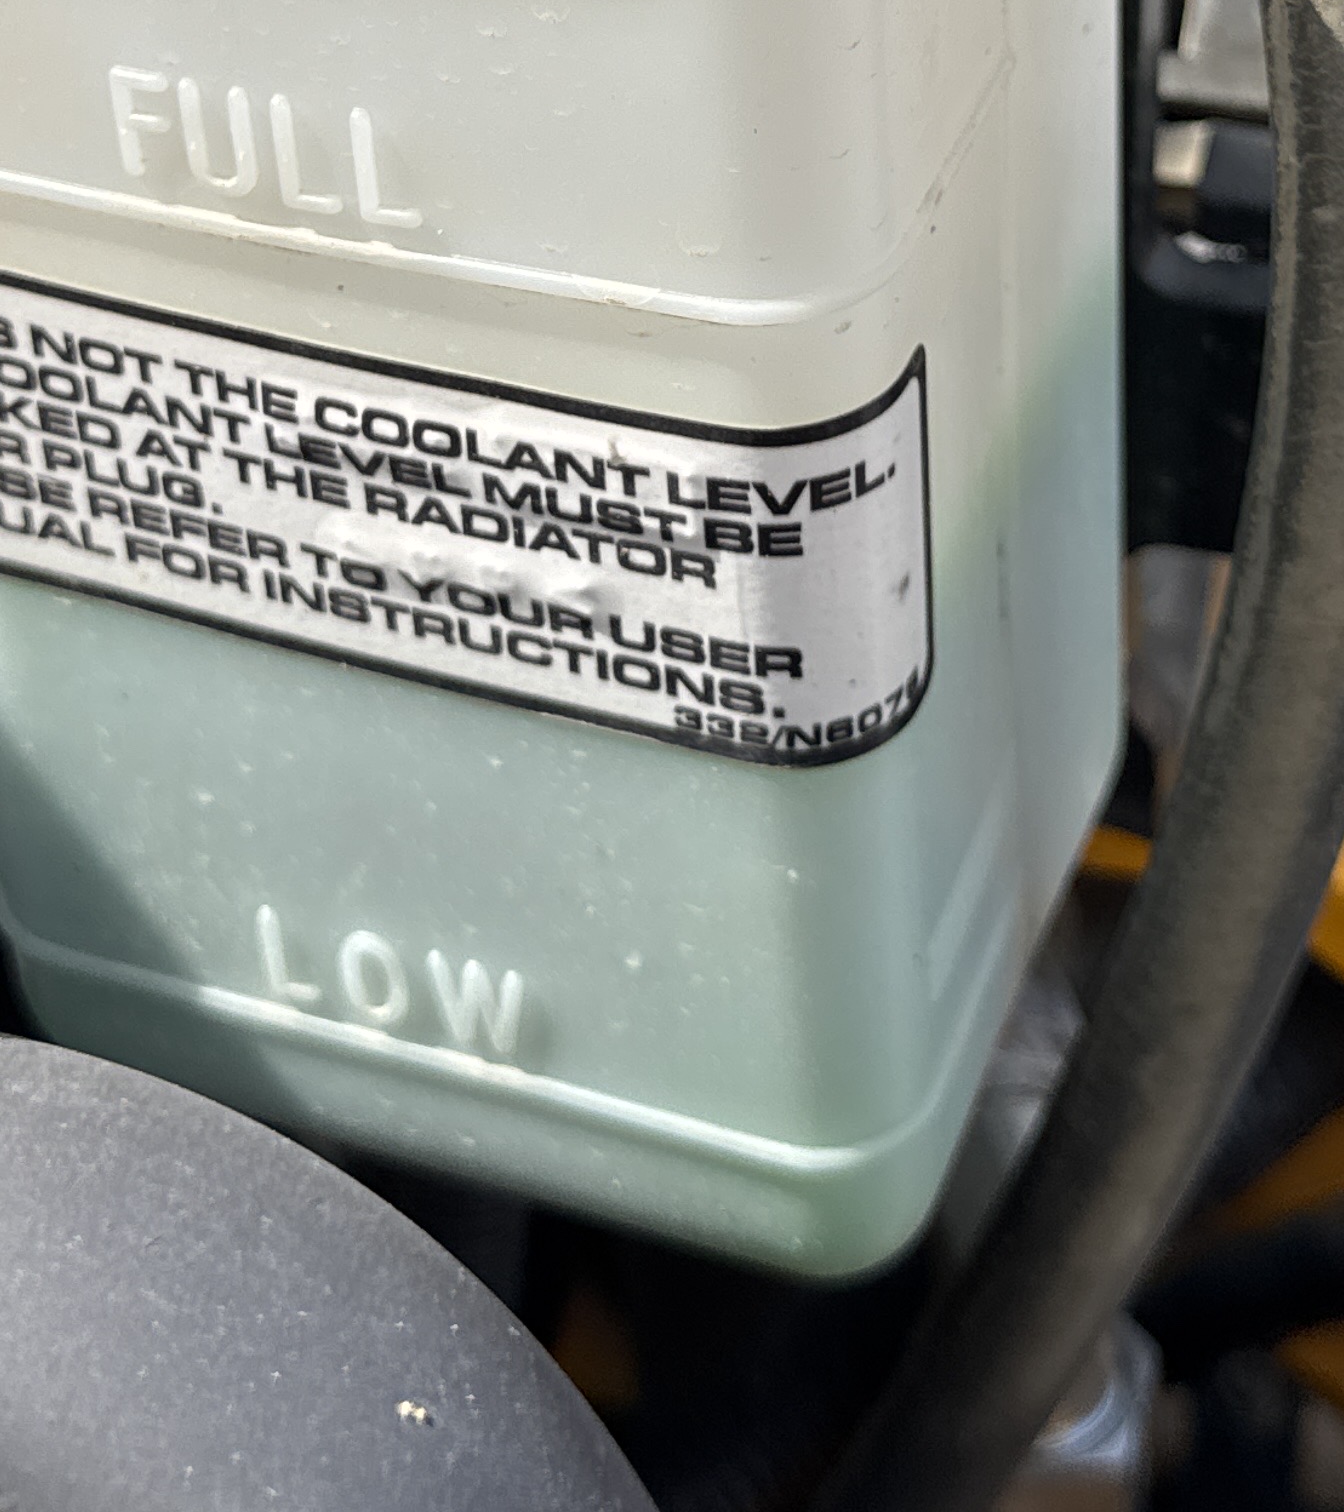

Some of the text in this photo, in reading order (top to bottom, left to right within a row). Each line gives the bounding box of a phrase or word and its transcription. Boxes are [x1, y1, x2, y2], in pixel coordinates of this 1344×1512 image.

[109, 65, 423, 228] FULL
[31, 323, 161, 384] NOT
[174, 358, 299, 424] THE
[314, 395, 650, 497] COOLANT
[667, 460, 895, 514] LEVEL.
[43, 439, 224, 515] PLUG.
[264, 422, 472, 498] LEVEL
[482, 472, 687, 542] MUST
[704, 517, 803, 556] BE
[88, 488, 289, 568] REFER
[301, 542, 387, 591] TO
[398, 569, 594, 639] YOUR
[609, 614, 803, 679] USER
[137, 431, 210, 471] AT
[223, 447, 351, 509] THE
[364, 481, 716, 589] RADIATOR
[124, 531, 248, 593] FOR
[264, 568, 786, 719] INSTRUCTIONS.
[256, 903, 525, 1054] LOW
